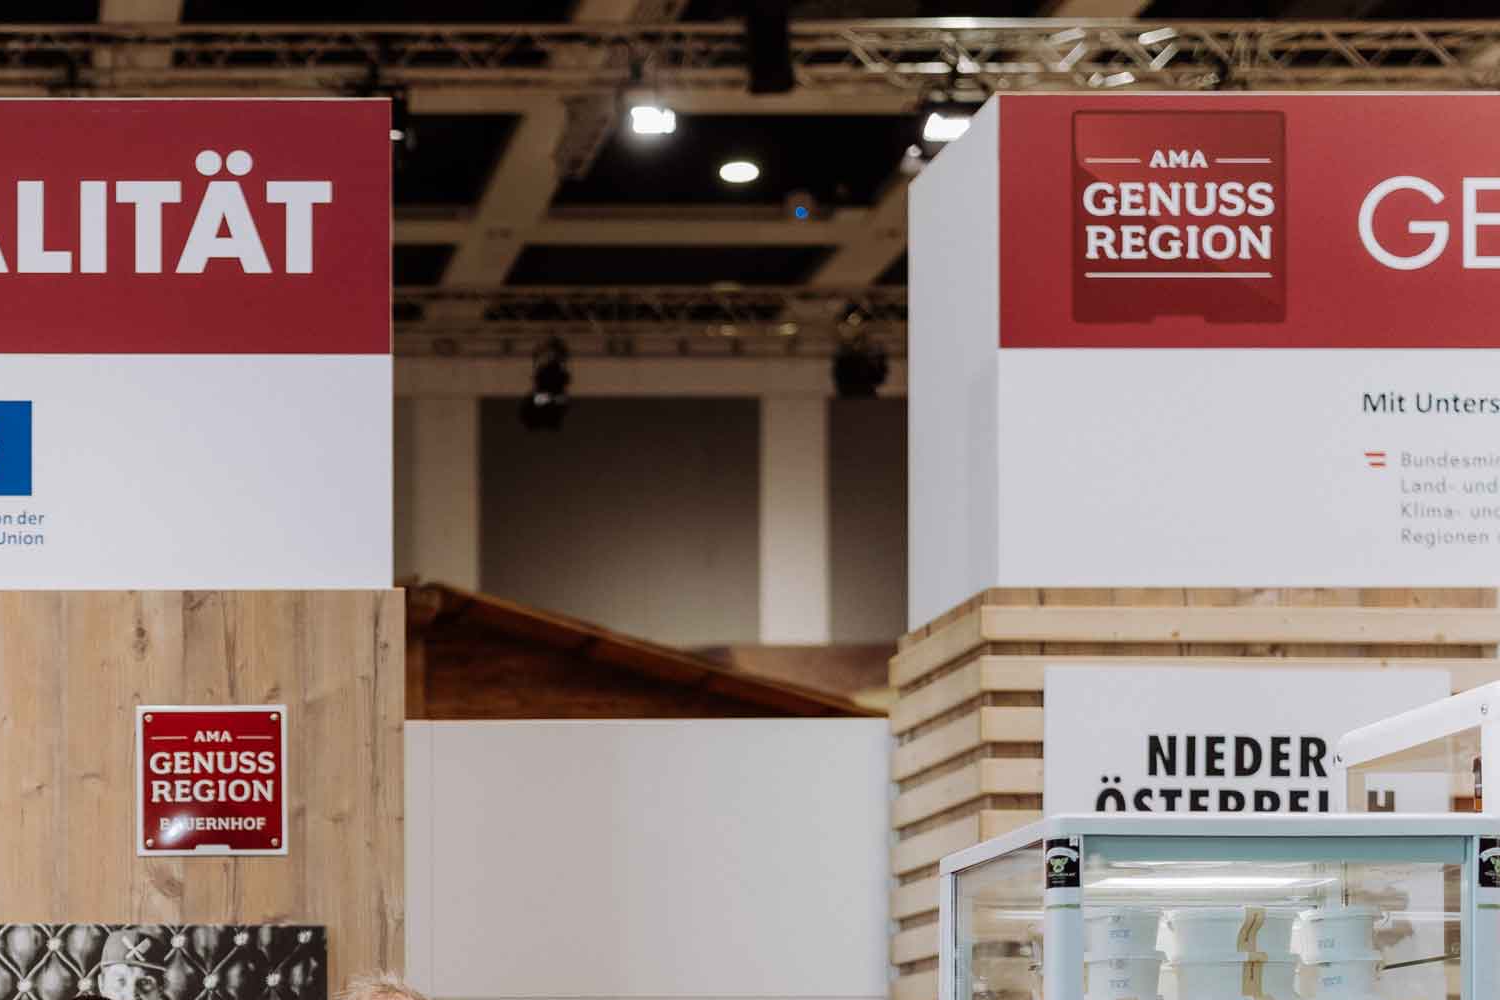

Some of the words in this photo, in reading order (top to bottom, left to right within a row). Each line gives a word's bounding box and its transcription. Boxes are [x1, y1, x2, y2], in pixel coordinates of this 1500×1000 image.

[1148, 149, 1209, 169] AMA
[1082, 181, 1275, 217] GENUSS
[1085, 224, 1273, 260] REGION
[1363, 392, 1405, 413] Mit
[1400, 476, 1453, 495] Land-
[1462, 476, 1498, 494] und
[16, 510, 45, 526] der
[1400, 502, 1461, 519] Klima-
[1400, 527, 1489, 550] Regionen
[193, 730, 233, 743] AMA
[149, 750, 277, 775] GENUSS
[1147, 735, 1328, 778] NIEDER
[150, 779, 275, 803] REGION
